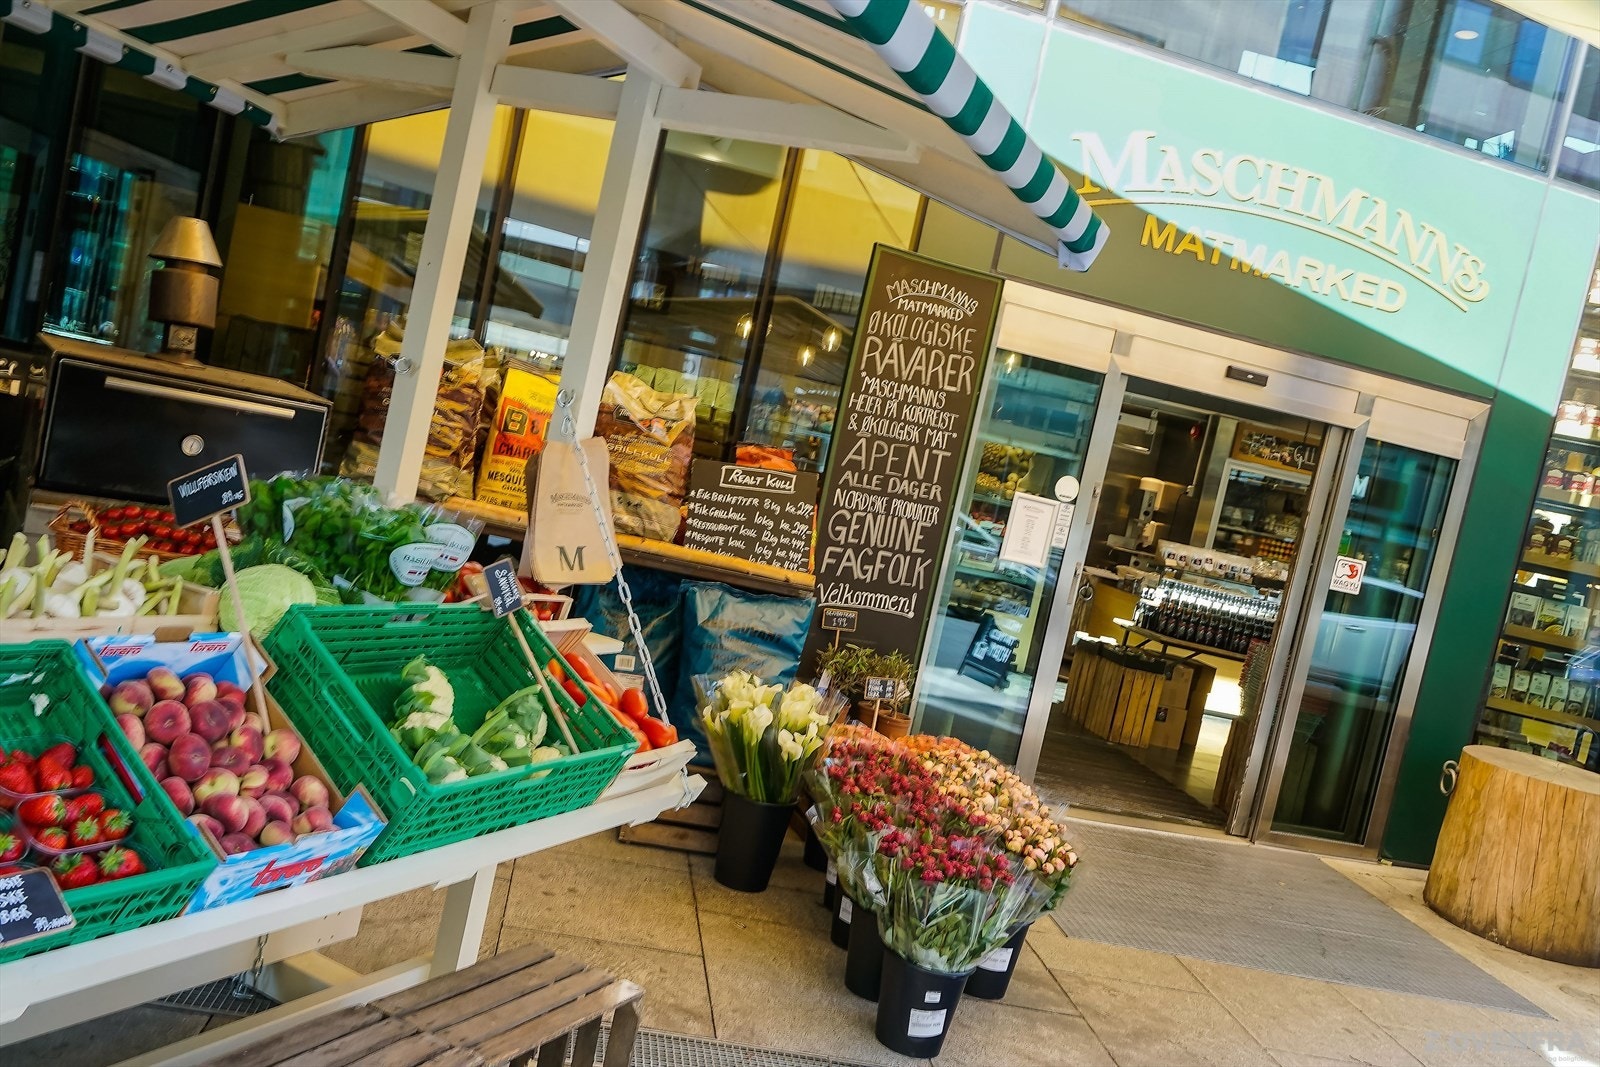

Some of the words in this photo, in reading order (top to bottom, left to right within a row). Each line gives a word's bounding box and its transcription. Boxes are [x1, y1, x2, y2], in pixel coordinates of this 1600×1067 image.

[1140, 213, 1407, 313] MATMARKED
[885, 279, 979, 314] MASCHMANNS
[897, 298, 965, 321] MATMARKED
[867, 310, 977, 354] ØKOLOGISKE
[860, 335, 976, 395] RÅVARER
[847, 412, 858, 431] &
[860, 416, 922, 443] ØKOLOGISK
[848, 392, 881, 415] HEIER
[885, 398, 900, 418] PÅ
[901, 403, 960, 431] KORTREIST
[498, 442, 534, 460] CHAR
[606, 442, 671, 465] GRILLKULL
[841, 431, 951, 485] ÅPENT
[728, 468, 764, 486] REALT
[766, 474, 792, 491] KULL
[838, 470, 884, 491] ALLE
[887, 477, 942, 502] DAGER
[833, 488, 889, 514] NORDISKE
[891, 499, 940, 525] PRODUKTER
[828, 509, 931, 554] GENUINE
[556, 545, 587, 571] M
[820, 547, 932, 590] FAGFOLK
[817, 582, 917, 618] Velkommen!
